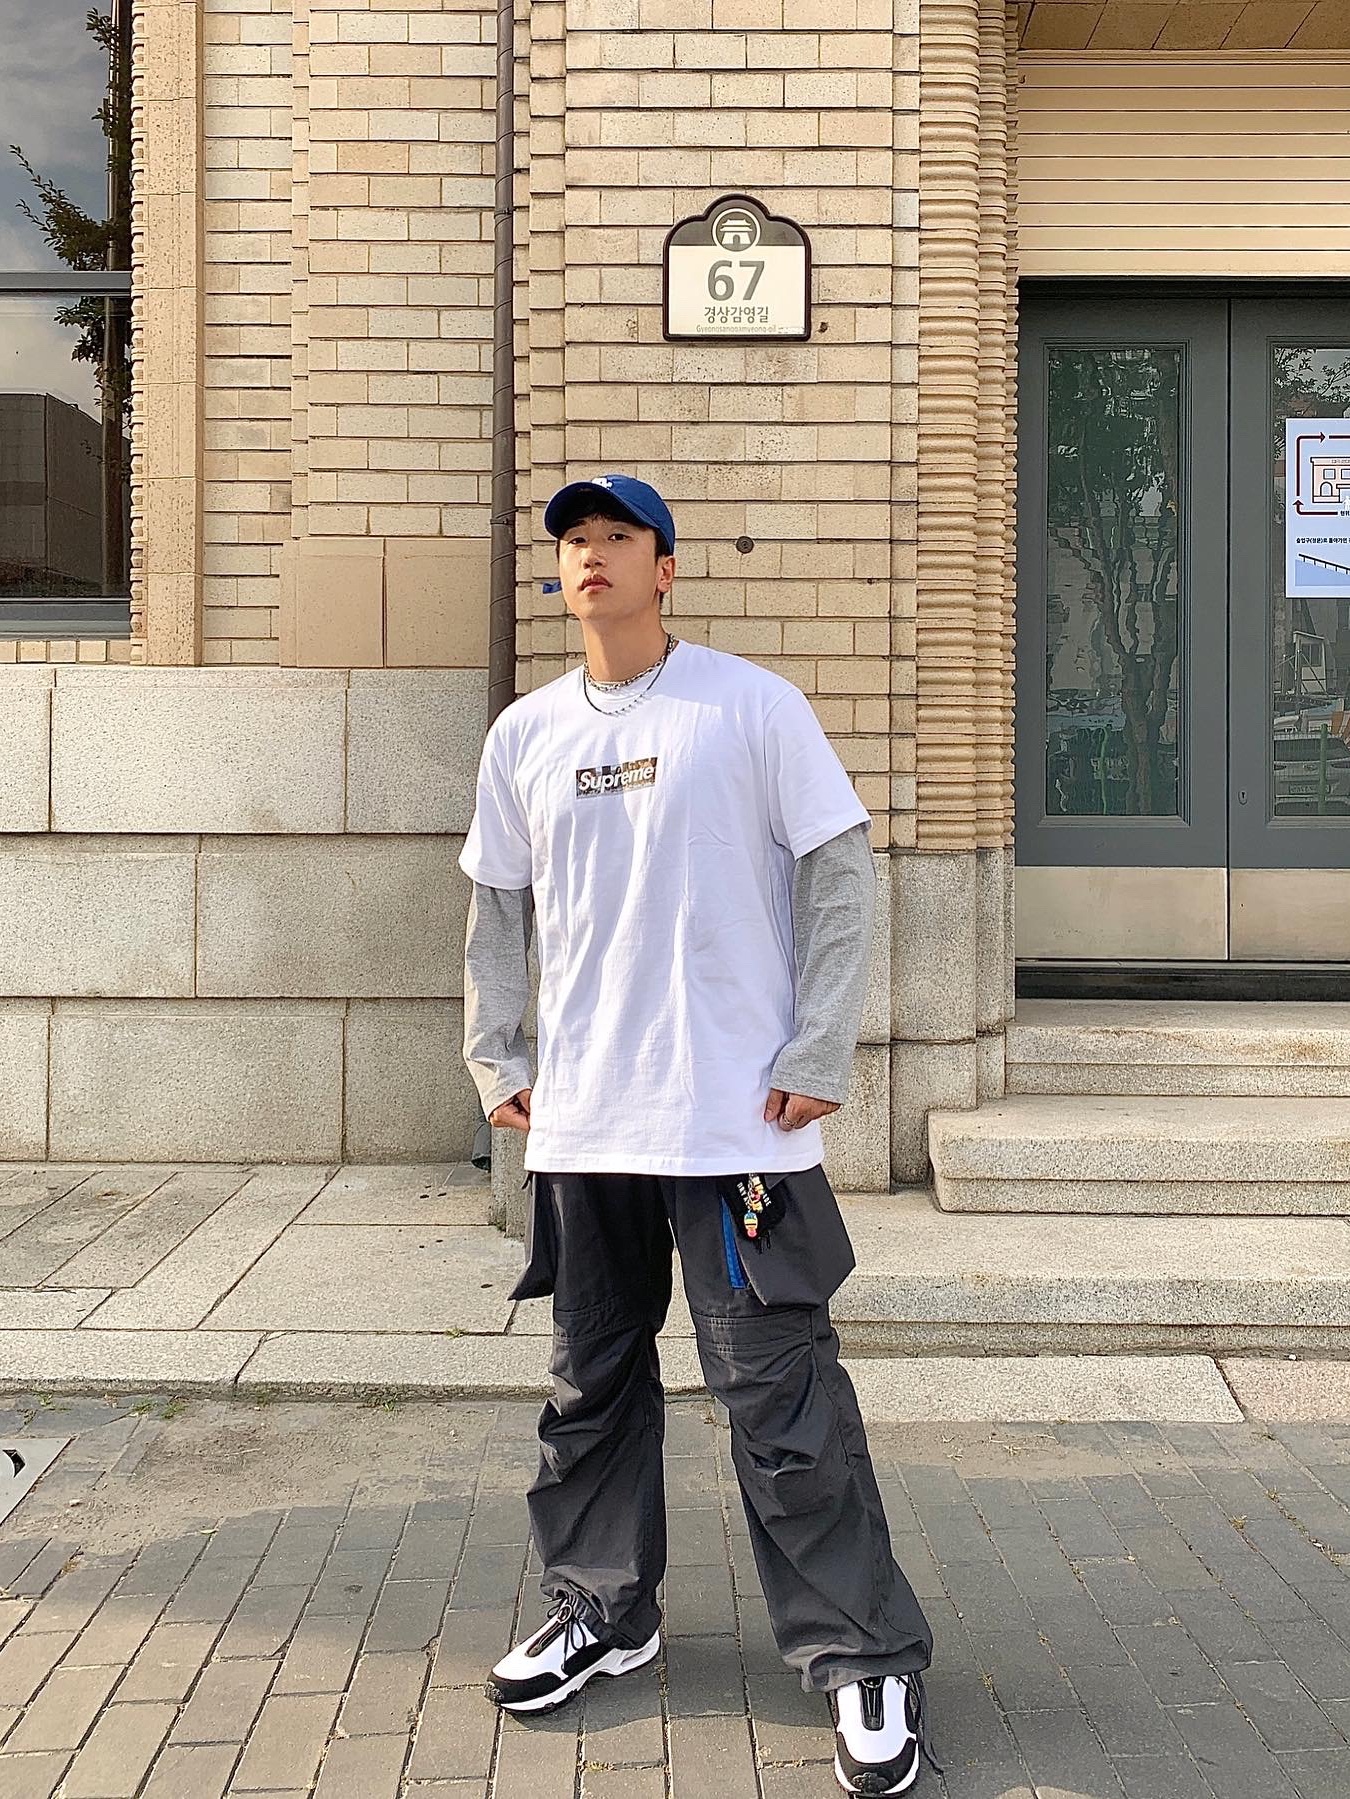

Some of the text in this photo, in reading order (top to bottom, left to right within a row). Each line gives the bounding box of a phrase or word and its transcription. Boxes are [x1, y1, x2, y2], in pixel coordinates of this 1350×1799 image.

[707, 259, 765, 302] 67
[704, 306, 769, 324] 경상감영길
[578, 766, 655, 793] Supreme
